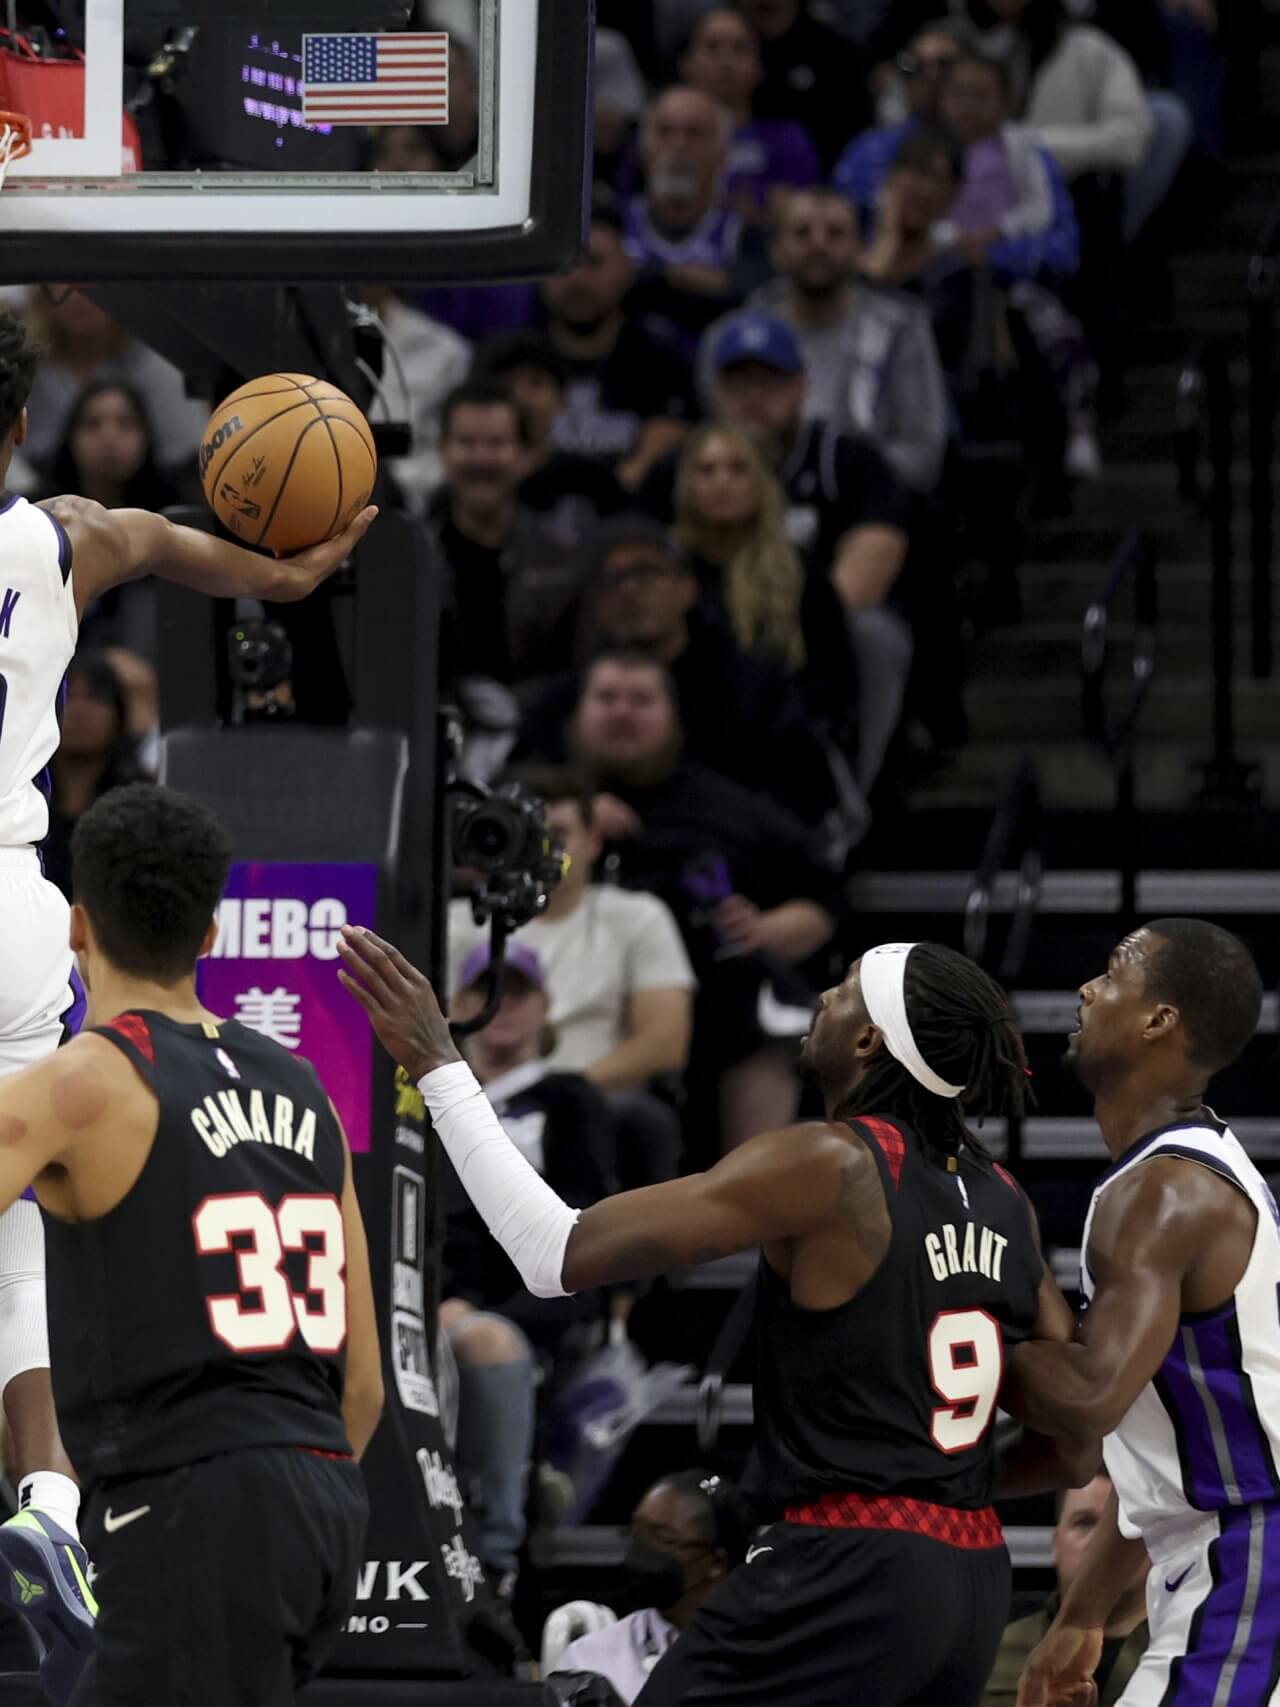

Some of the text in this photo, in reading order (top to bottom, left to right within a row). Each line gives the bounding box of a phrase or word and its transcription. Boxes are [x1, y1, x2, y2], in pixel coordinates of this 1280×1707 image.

[190, 1088, 318, 1161] CAMARA
[191, 1190, 348, 1354] 33
[924, 1221, 1009, 1282] GRANT
[928, 1306, 1004, 1454] 9
